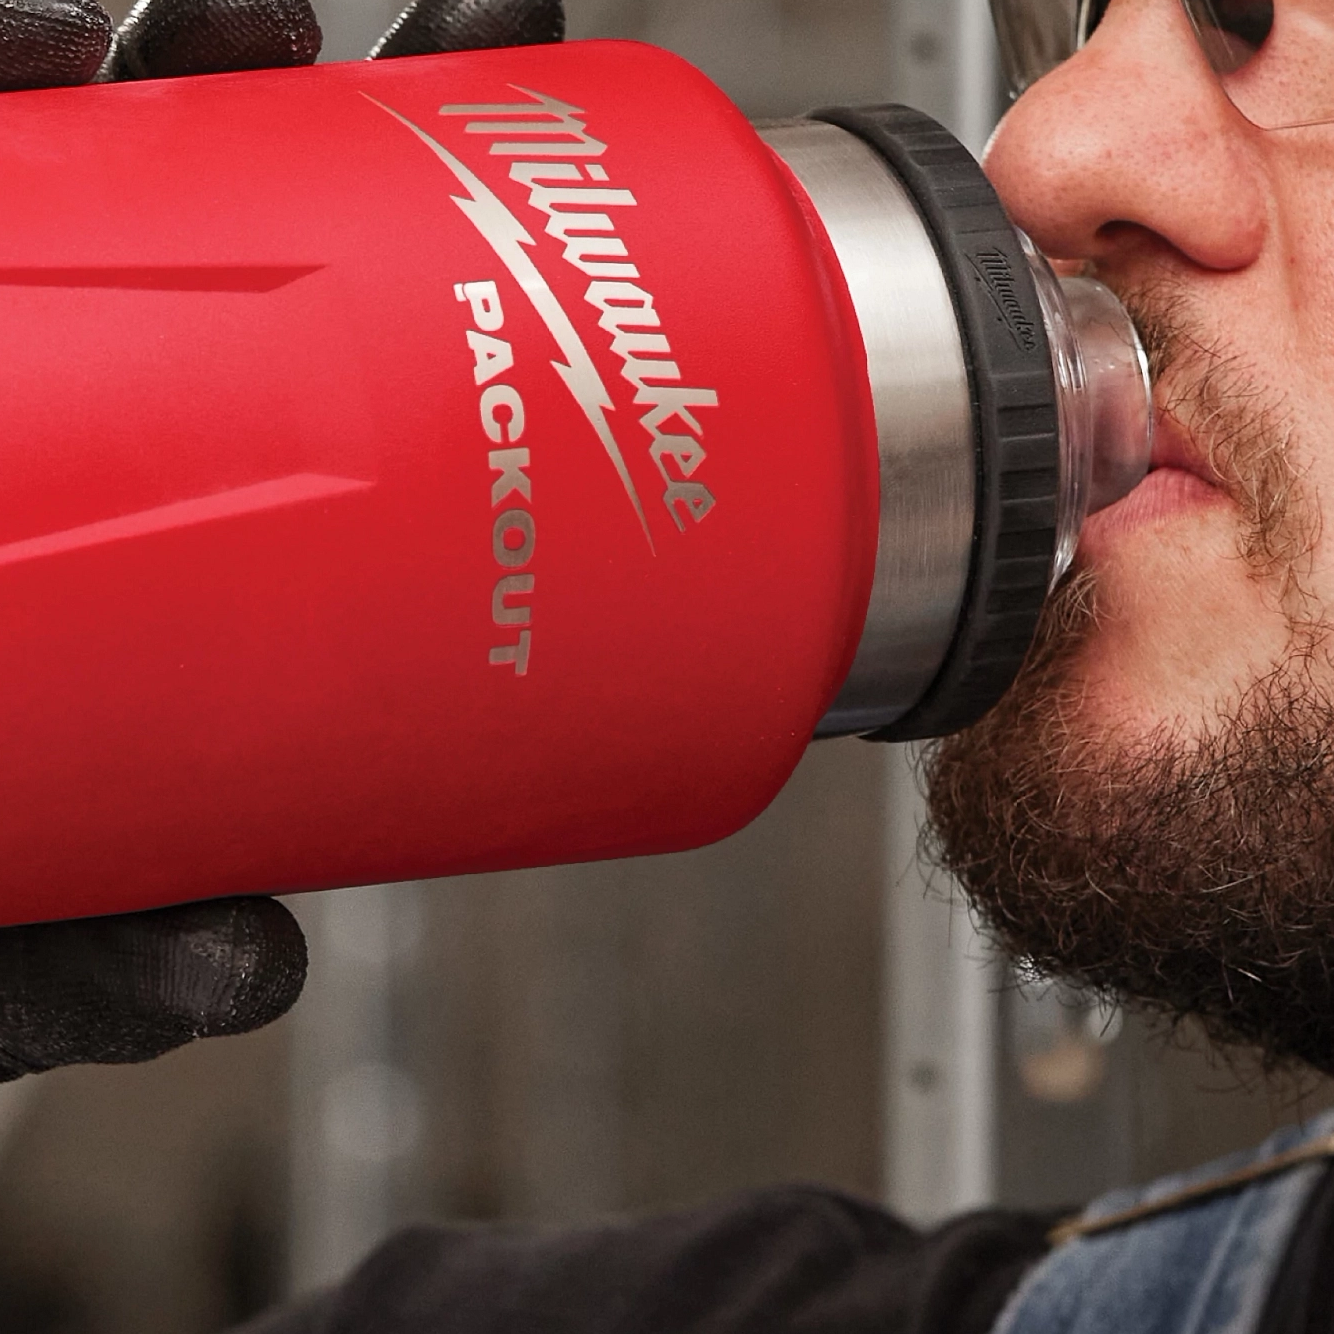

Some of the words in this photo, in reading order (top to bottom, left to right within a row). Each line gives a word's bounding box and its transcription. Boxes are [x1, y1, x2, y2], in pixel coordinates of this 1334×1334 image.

[438, 83, 719, 533] Milwaukee
[453, 279, 535, 676] PACKOUT
[974, 245, 1037, 353] Milwaukee
